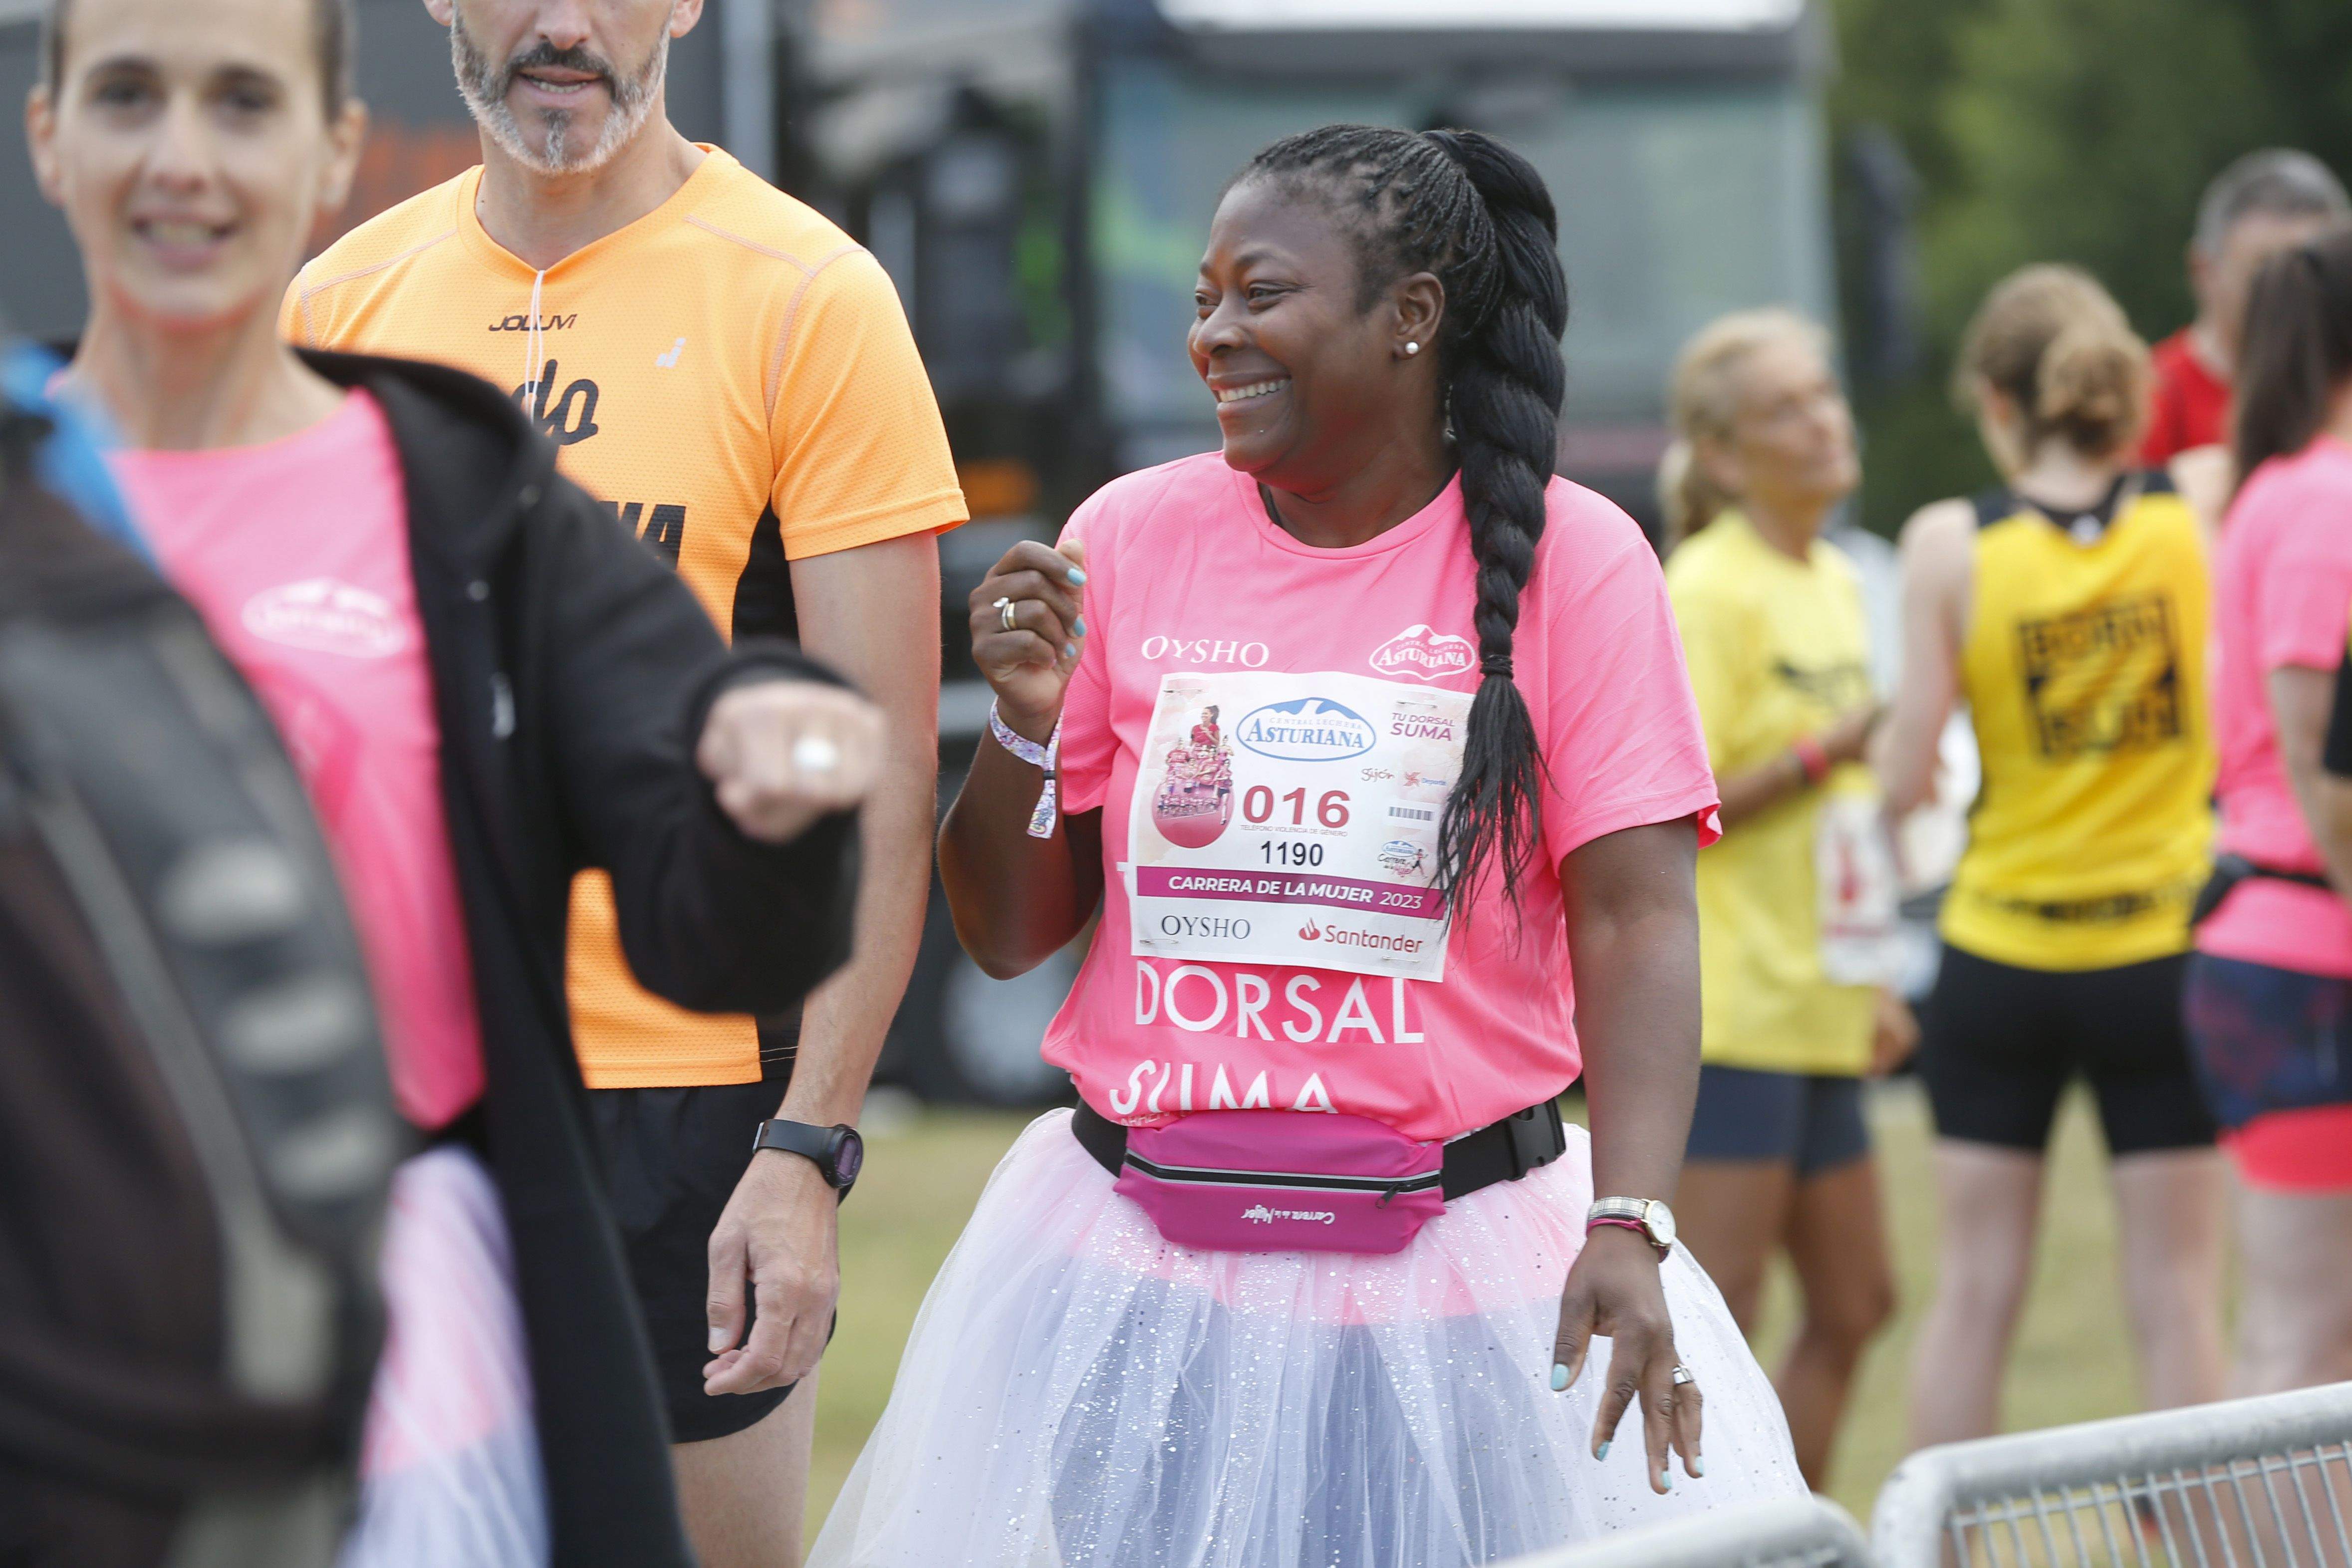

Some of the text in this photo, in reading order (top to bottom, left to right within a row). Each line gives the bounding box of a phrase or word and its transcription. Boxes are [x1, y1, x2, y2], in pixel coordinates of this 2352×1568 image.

[1141, 635, 1270, 668] OYSHO
[1375, 648, 1467, 668] ASTURIANA
[1245, 718, 1365, 748] ASTURIANA
[1270, 717, 1313, 725] CENTRAL
[1390, 722, 1452, 741] SUMA
[1392, 712, 1456, 727] TU DORSAL
[1243, 785, 1350, 829] 016
[1260, 840, 1323, 867] 1190
[1168, 875, 1423, 910] CARRERA DE LA MUJER 2023
[1161, 915, 1251, 940] OYSHO
[1324, 924, 1424, 954] Santander
[1135, 960, 1424, 1044] DORSAL
